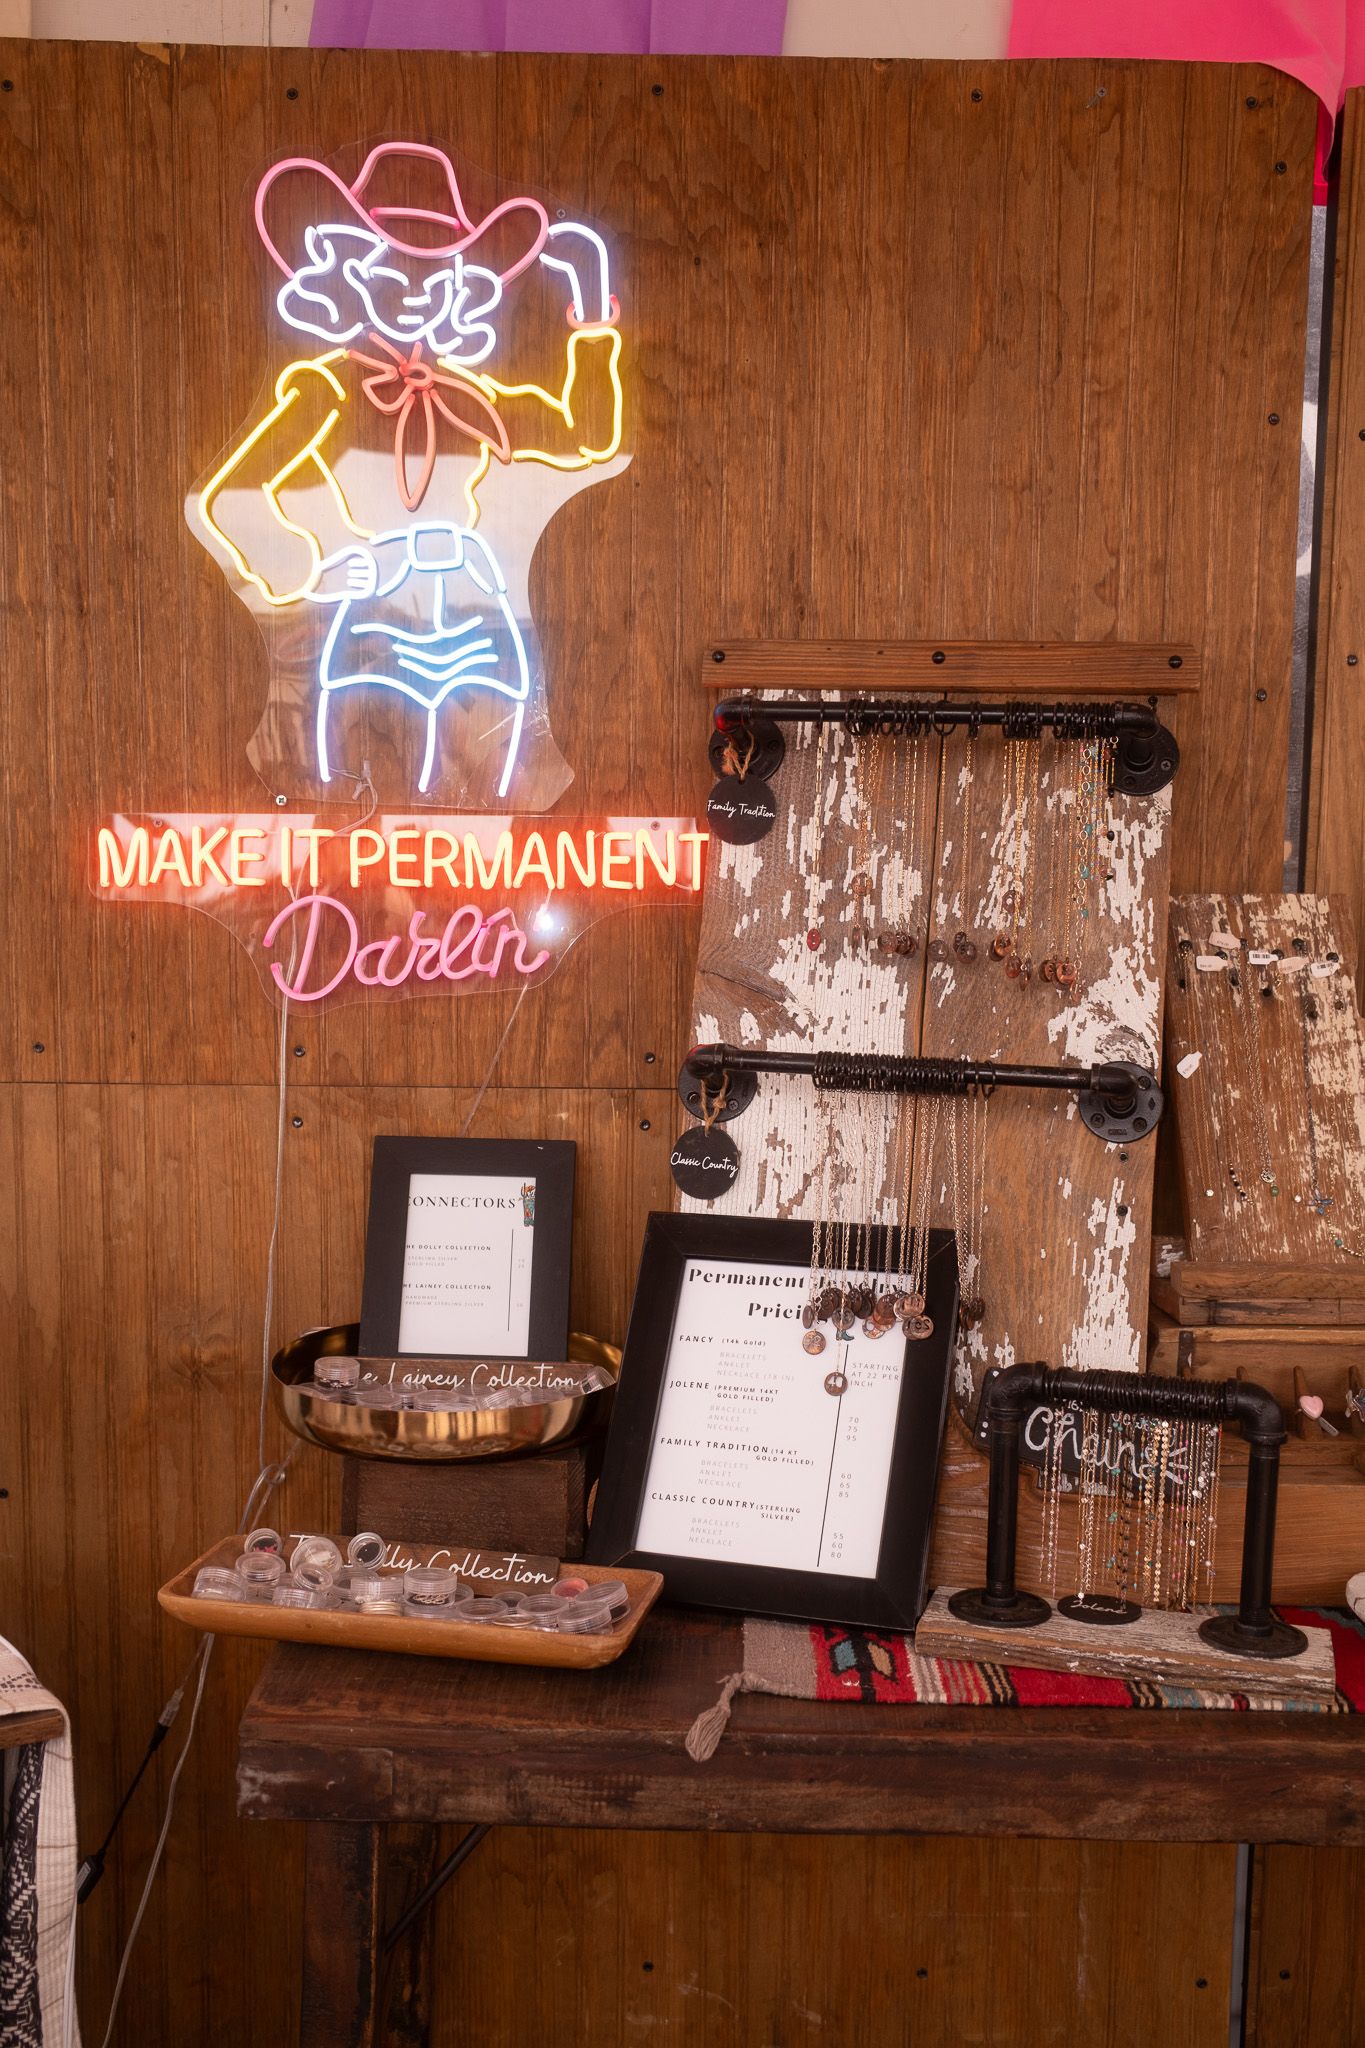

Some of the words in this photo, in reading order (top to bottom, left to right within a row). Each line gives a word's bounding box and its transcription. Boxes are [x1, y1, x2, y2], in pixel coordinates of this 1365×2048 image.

[707, 800, 737, 818] Family
[739, 803, 776, 819] Tradition
[98, 826, 267, 888] MAKE
[280, 828, 336, 888] IT
[350, 828, 709, 892] PERMANENT
[670, 1151, 701, 1166] Classic
[701, 1156, 738, 1178] Country
[408, 1195, 516, 1210] ONNECTORS
[689, 1268, 805, 1289] Permanent
[679, 1334, 714, 1343] FANCY
[851, 1362, 898, 1372] STARTING
[470, 1363, 580, 1391] Collection
[882, 1373, 900, 1381] PER
[669, 1380, 710, 1390] JOLENE
[714, 1384, 756, 1393] (PREMIUM
[850, 1380, 873, 1388] INCH
[717, 1392, 739, 1400] GOLD
[742, 1394, 775, 1404] FILLED)
[849, 1416, 860, 1424] 70
[706, 1423, 750, 1433] NECKLACE
[846, 1434, 857, 1442] 95
[660, 1437, 701, 1448] FAMILY
[706, 1441, 769, 1453] TRADITION
[700, 1459, 749, 1470] BRACELETS
[781, 1457, 815, 1466] FILLED)
[699, 1469, 733, 1478] ANKLET
[697, 1478, 742, 1489] NECKLACE
[651, 1492, 697, 1503] CLASSIC
[702, 1497, 755, 1509] COUNTRY
[691, 1517, 741, 1528] BRACELETS
[760, 1512, 794, 1522] SILVER)
[690, 1526, 723, 1536] ANKLET
[833, 1532, 844, 1540] 55
[688, 1536, 733, 1547] NECKLACE
[831, 1542, 843, 1550] 60
[427, 1549, 554, 1584] Collection
